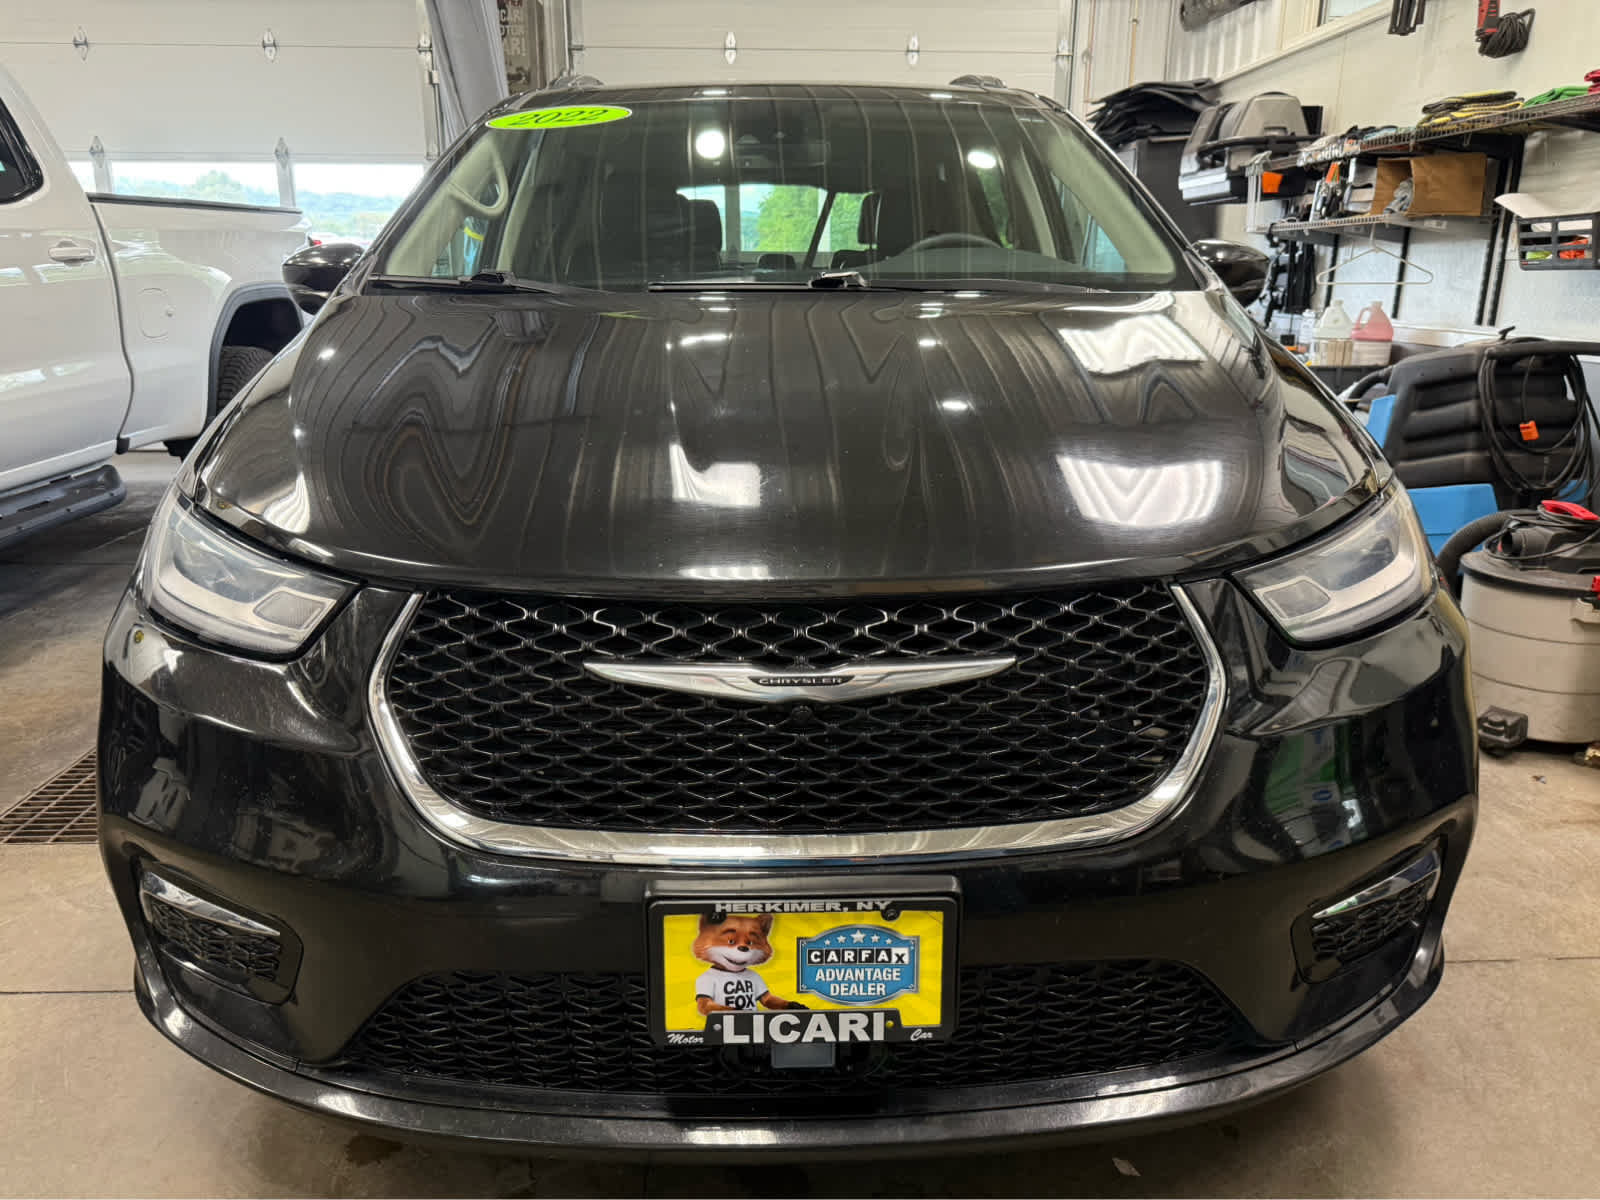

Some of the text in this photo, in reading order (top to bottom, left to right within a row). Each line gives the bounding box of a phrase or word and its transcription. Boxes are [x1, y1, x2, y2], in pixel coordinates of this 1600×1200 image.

[508, 109, 609, 126] 2022
[759, 677, 843, 685] CHRYSLER
[714, 900, 892, 913] HERKIMER, NY
[808, 949, 908, 964] CARFAX
[815, 967, 901, 982] ADVANTAGE
[723, 980, 754, 995] CAR
[830, 983, 886, 996] DEALER
[724, 994, 755, 1009] FOX
[722, 1012, 885, 1044] LICARI
[910, 1028, 933, 1041] Car
[666, 1033, 704, 1045] Motor
